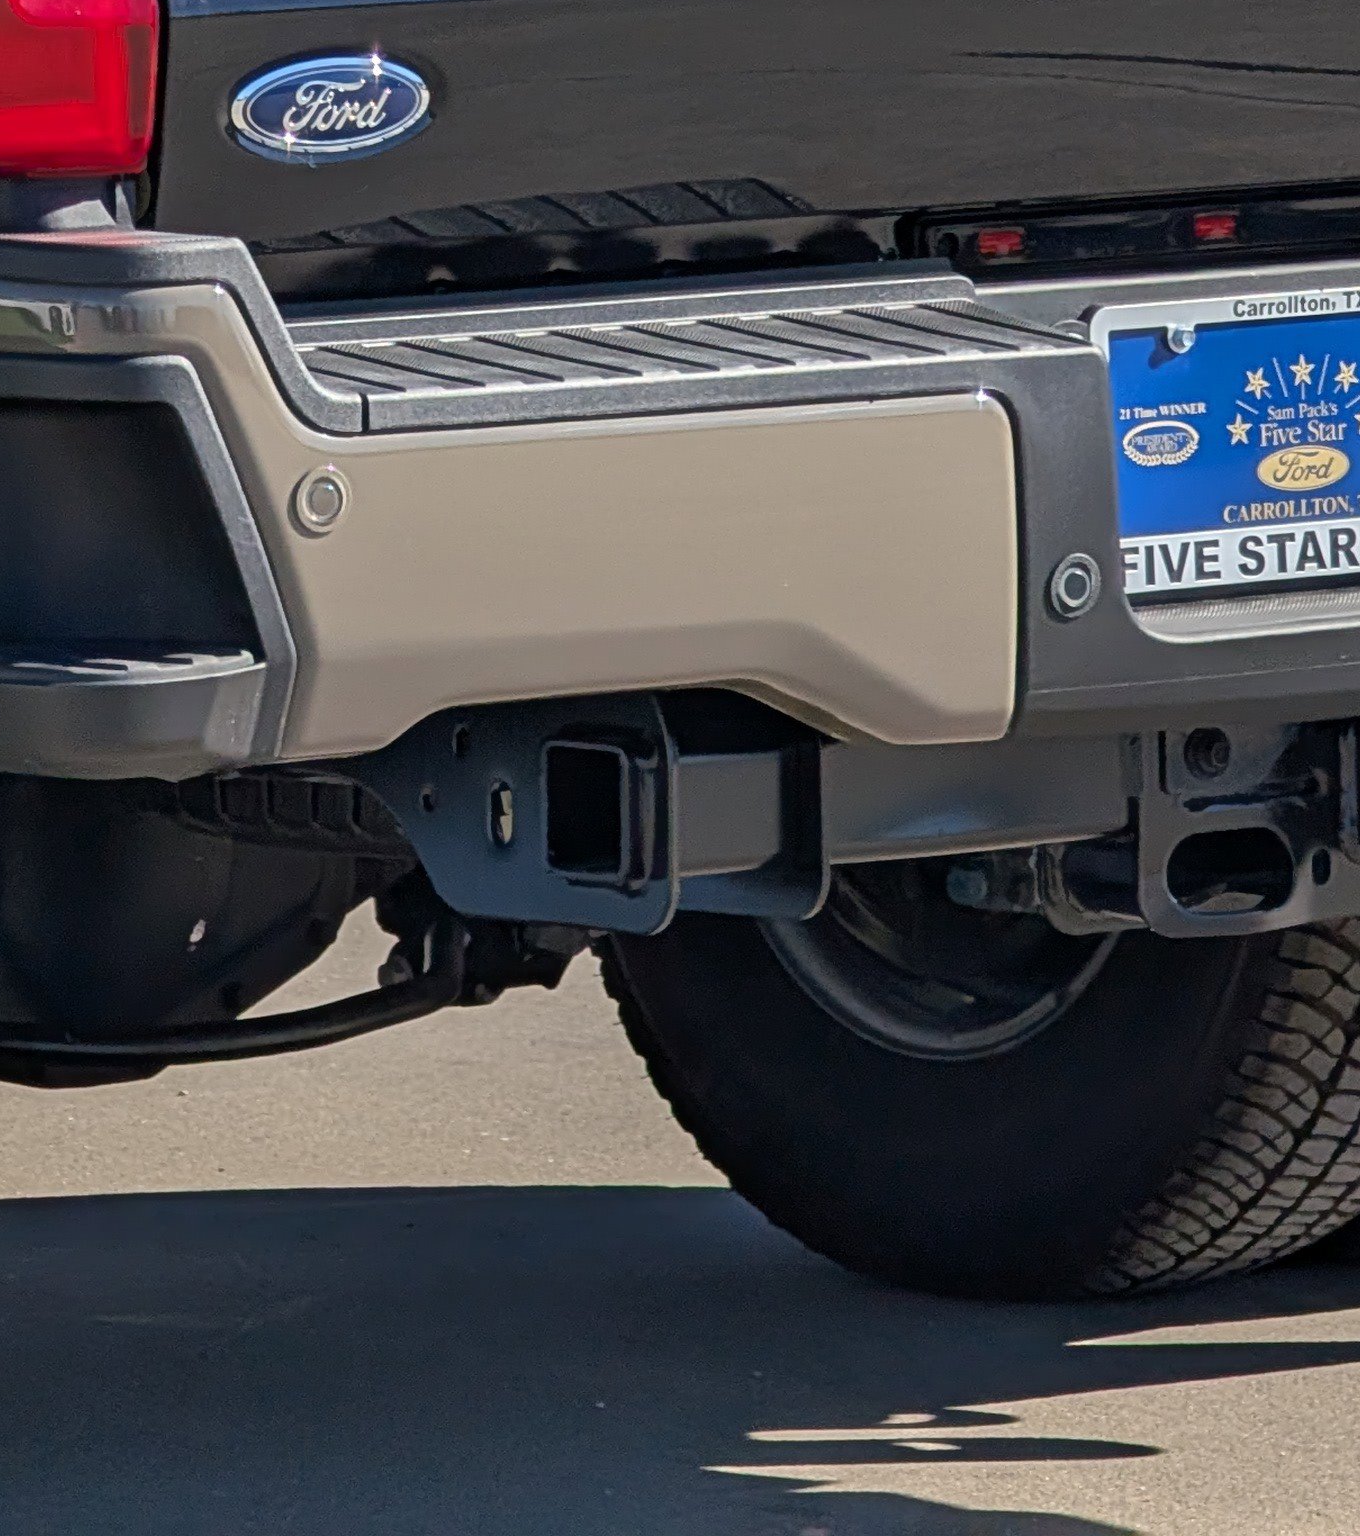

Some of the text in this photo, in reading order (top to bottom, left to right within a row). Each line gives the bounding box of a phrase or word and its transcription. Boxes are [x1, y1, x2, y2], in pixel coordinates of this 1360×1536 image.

[282, 78, 392, 133] Ford
[1232, 295, 1337, 318] Carrollton,
[1133, 407, 1157, 419] Time
[1158, 402, 1207, 416] WINNER
[1266, 400, 1339, 421] Sam Pack's
[1258, 419, 1348, 447] Five Star
[1273, 451, 1335, 483] Ford
[1223, 495, 1355, 524] CARROLLTON,
[1122, 538, 1222, 588] FIVE
[1237, 527, 1360, 577] STAR
